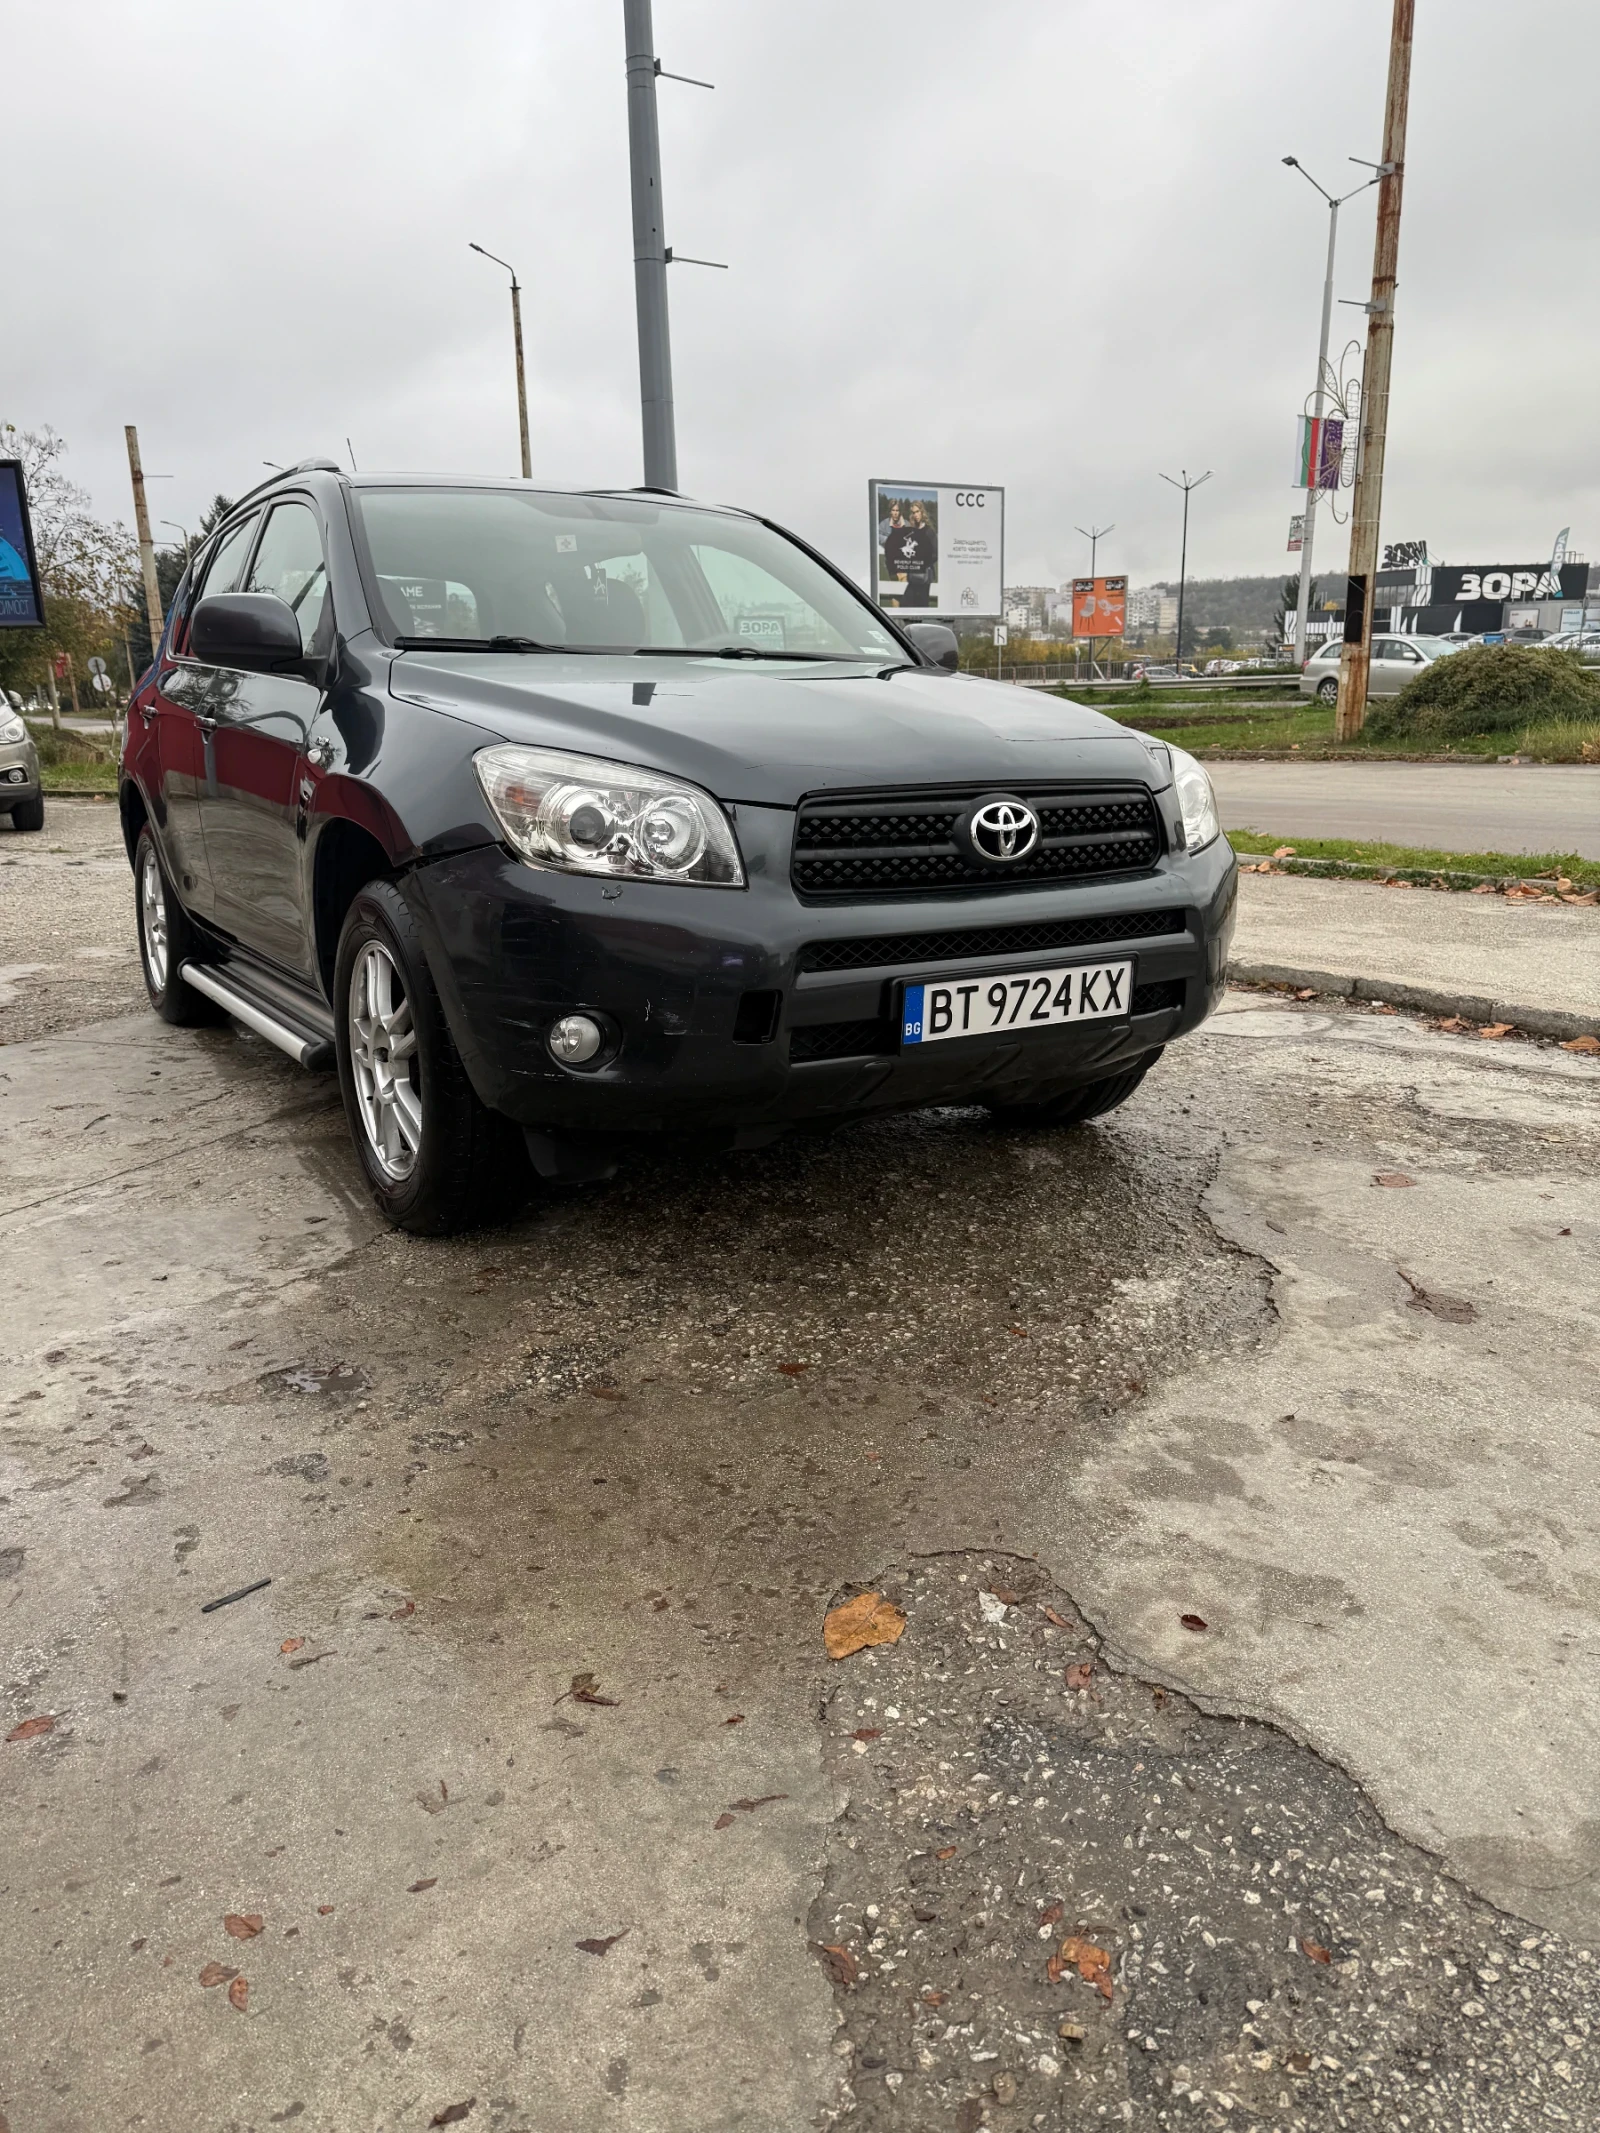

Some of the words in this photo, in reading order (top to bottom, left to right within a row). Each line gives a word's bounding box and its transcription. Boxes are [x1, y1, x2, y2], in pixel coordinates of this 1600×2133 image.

[956, 492, 985, 508] CCC
[1455, 571, 1563, 601] ЗОРА
[905, 1022, 921, 1037] BG
